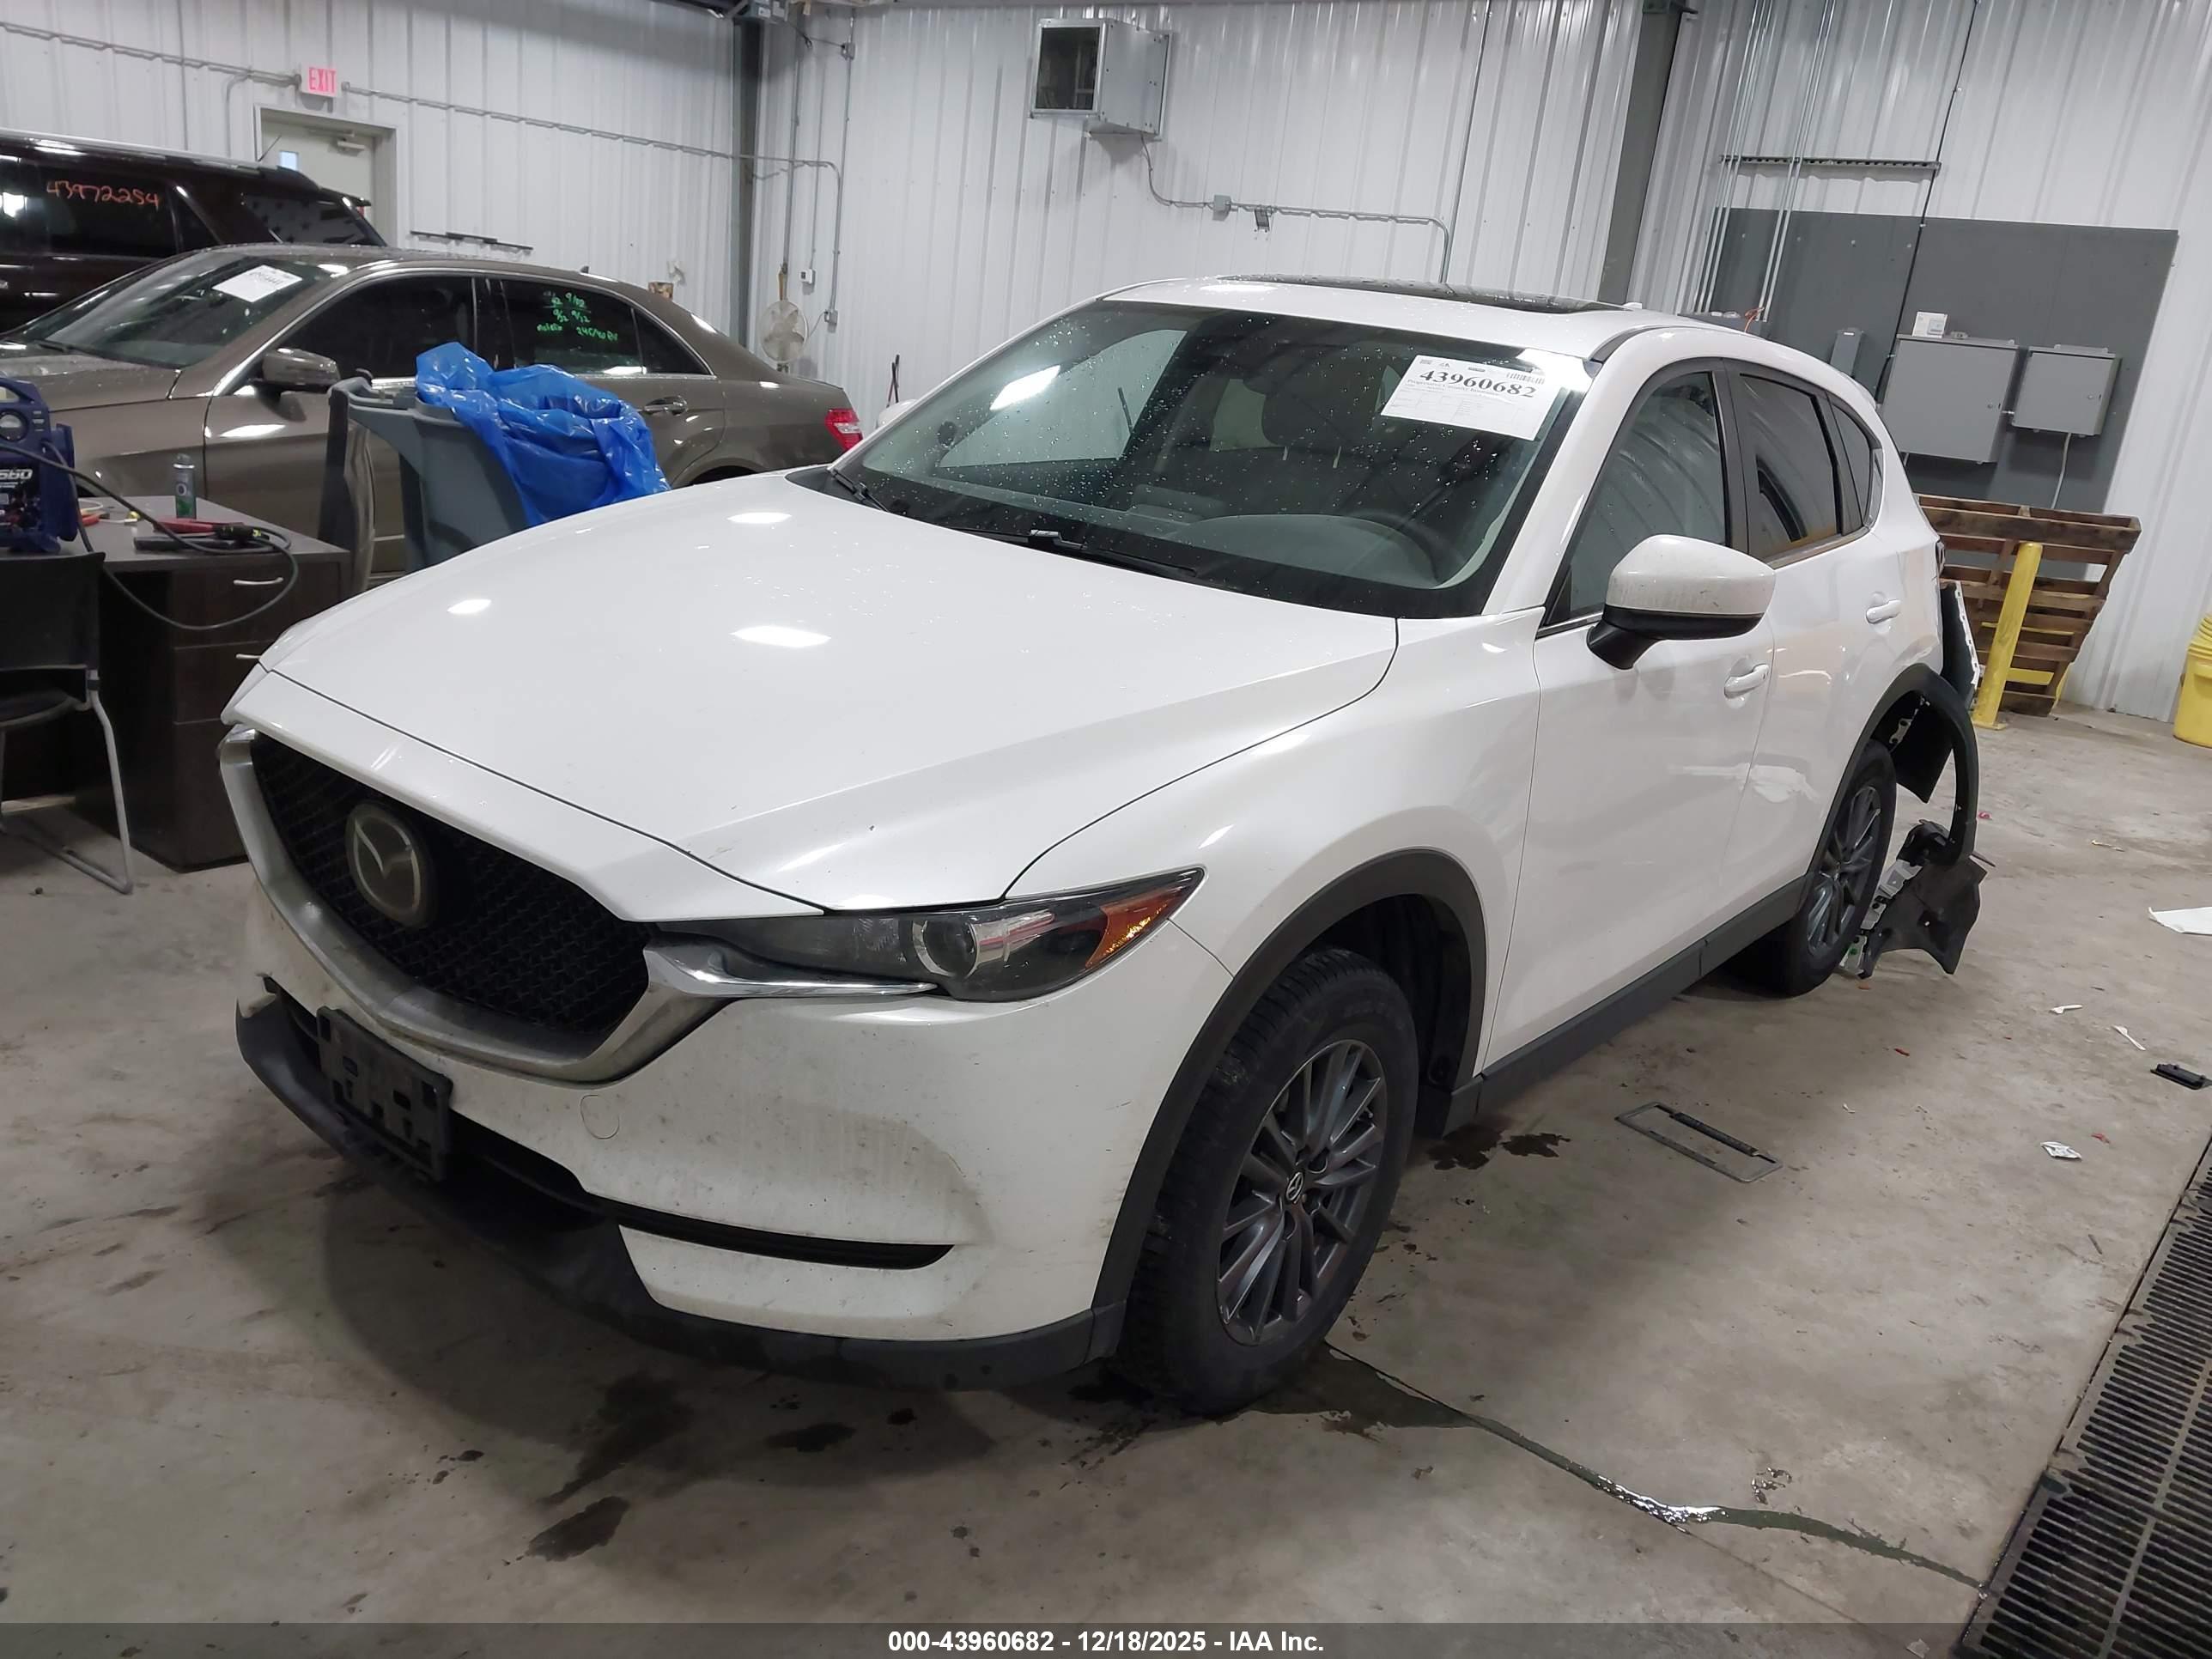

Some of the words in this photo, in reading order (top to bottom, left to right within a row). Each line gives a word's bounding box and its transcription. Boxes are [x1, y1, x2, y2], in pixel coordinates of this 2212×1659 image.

[309, 68, 336, 93] EXIT
[46, 180, 160, 210] 43972254
[1419, 370, 1537, 398] 43960682
